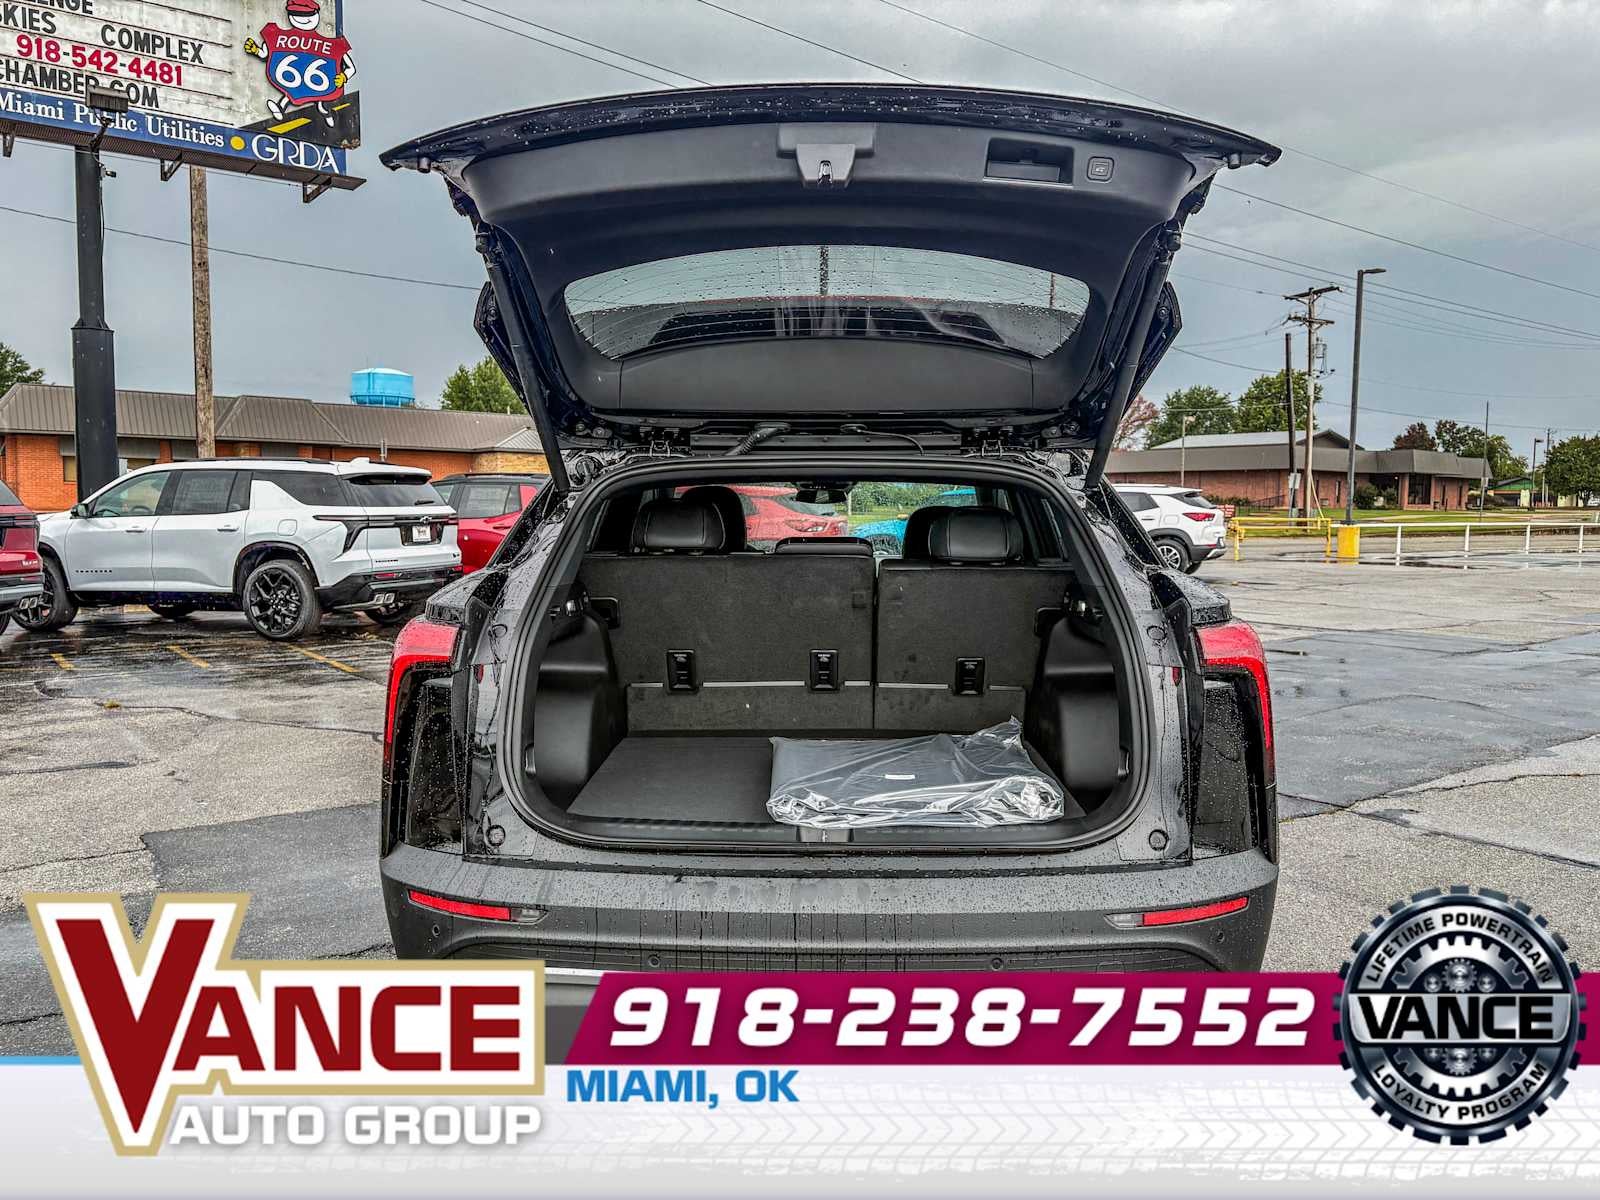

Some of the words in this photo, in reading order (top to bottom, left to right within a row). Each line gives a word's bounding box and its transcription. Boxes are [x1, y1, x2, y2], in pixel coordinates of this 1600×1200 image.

[0, 3, 57, 34] KIES
[101, 24, 205, 65] COMPLEX
[276, 35, 333, 55] ROUTE
[16, 34, 183, 87] 918-542-4481
[275, 54, 330, 92] 66
[0, 91, 65, 121] Miami
[145, 115, 225, 148] Utilities
[251, 133, 340, 174] GRDA
